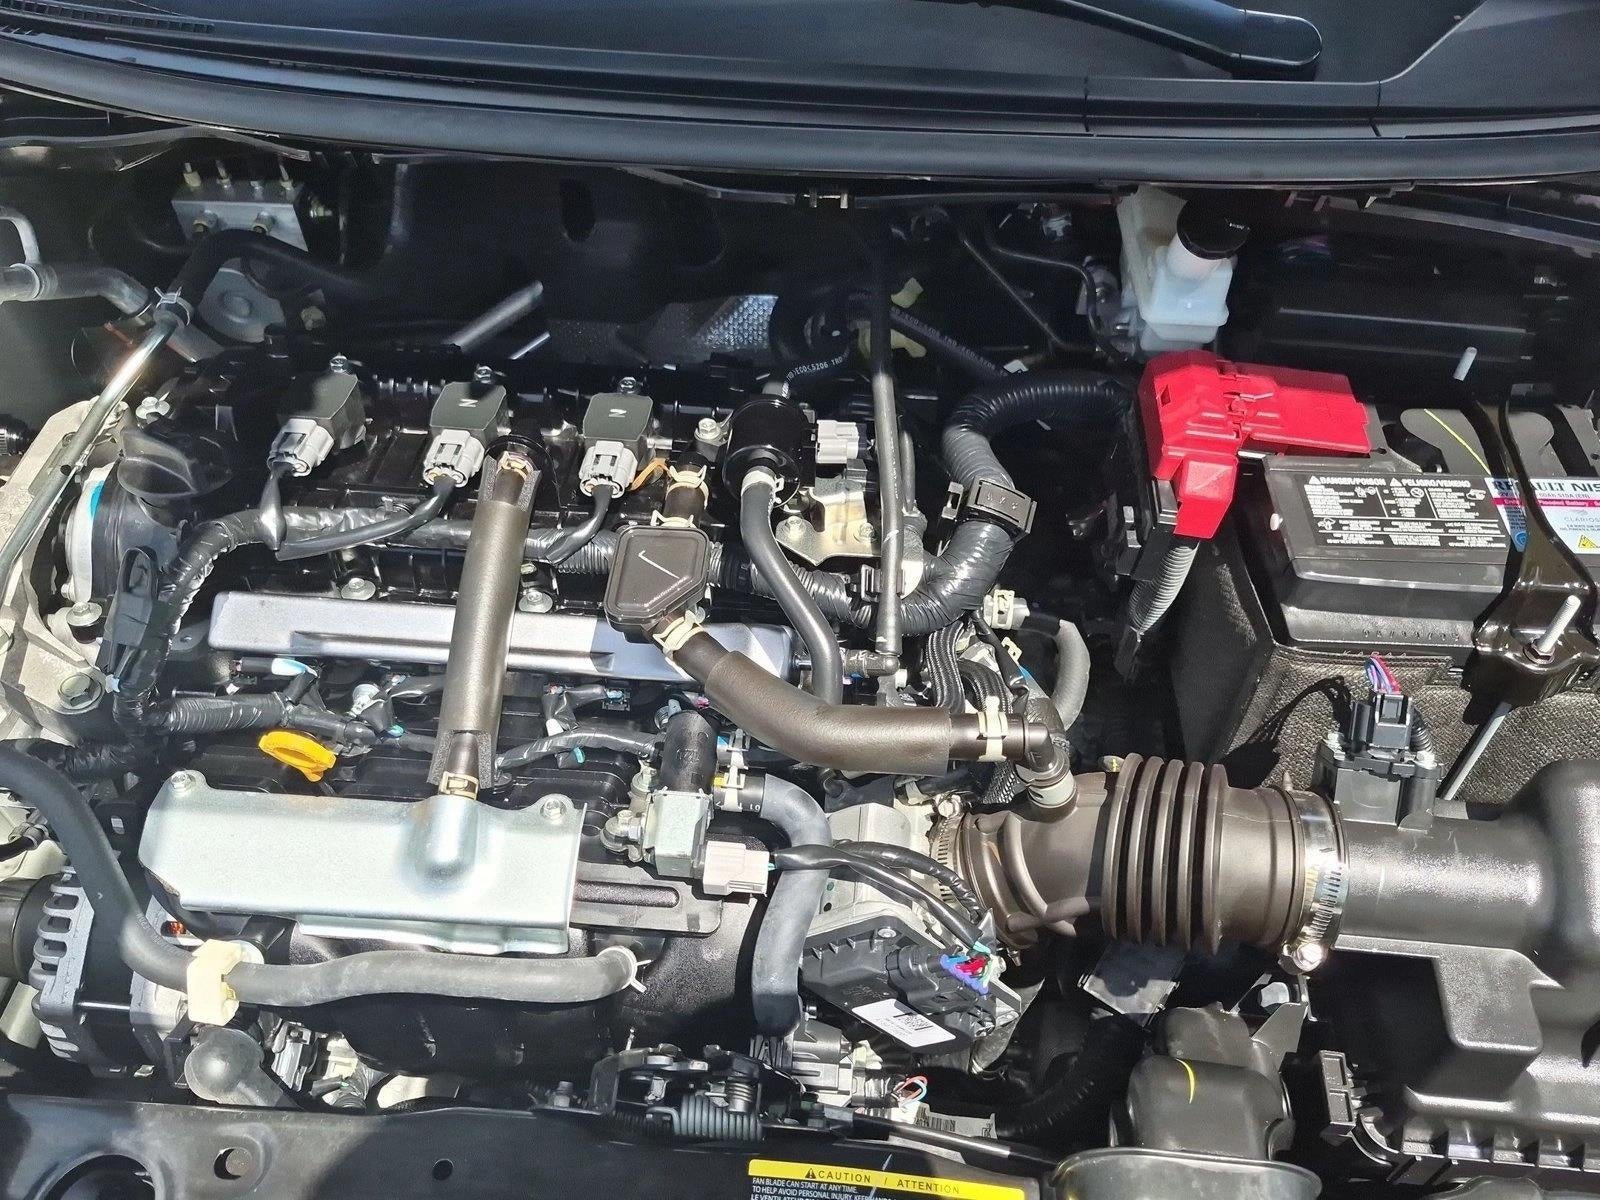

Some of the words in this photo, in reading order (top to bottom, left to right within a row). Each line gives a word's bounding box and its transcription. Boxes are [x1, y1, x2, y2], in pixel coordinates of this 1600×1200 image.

[752, 1177, 765, 1186] FAN
[765, 1178, 786, 1188] BLADE
[786, 1180, 800, 1189] CAN
[801, 1181, 819, 1190] START
[828, 1184, 842, 1192] ANY
[818, 1170, 871, 1184] CAUTION
[897, 1179, 960, 1194] ATTENTION
[752, 1185, 761, 1194] TO
[762, 1186, 778, 1195] HELP
[778, 1188, 798, 1196] AVOID
[798, 1190, 830, 1199] PERSONAL
